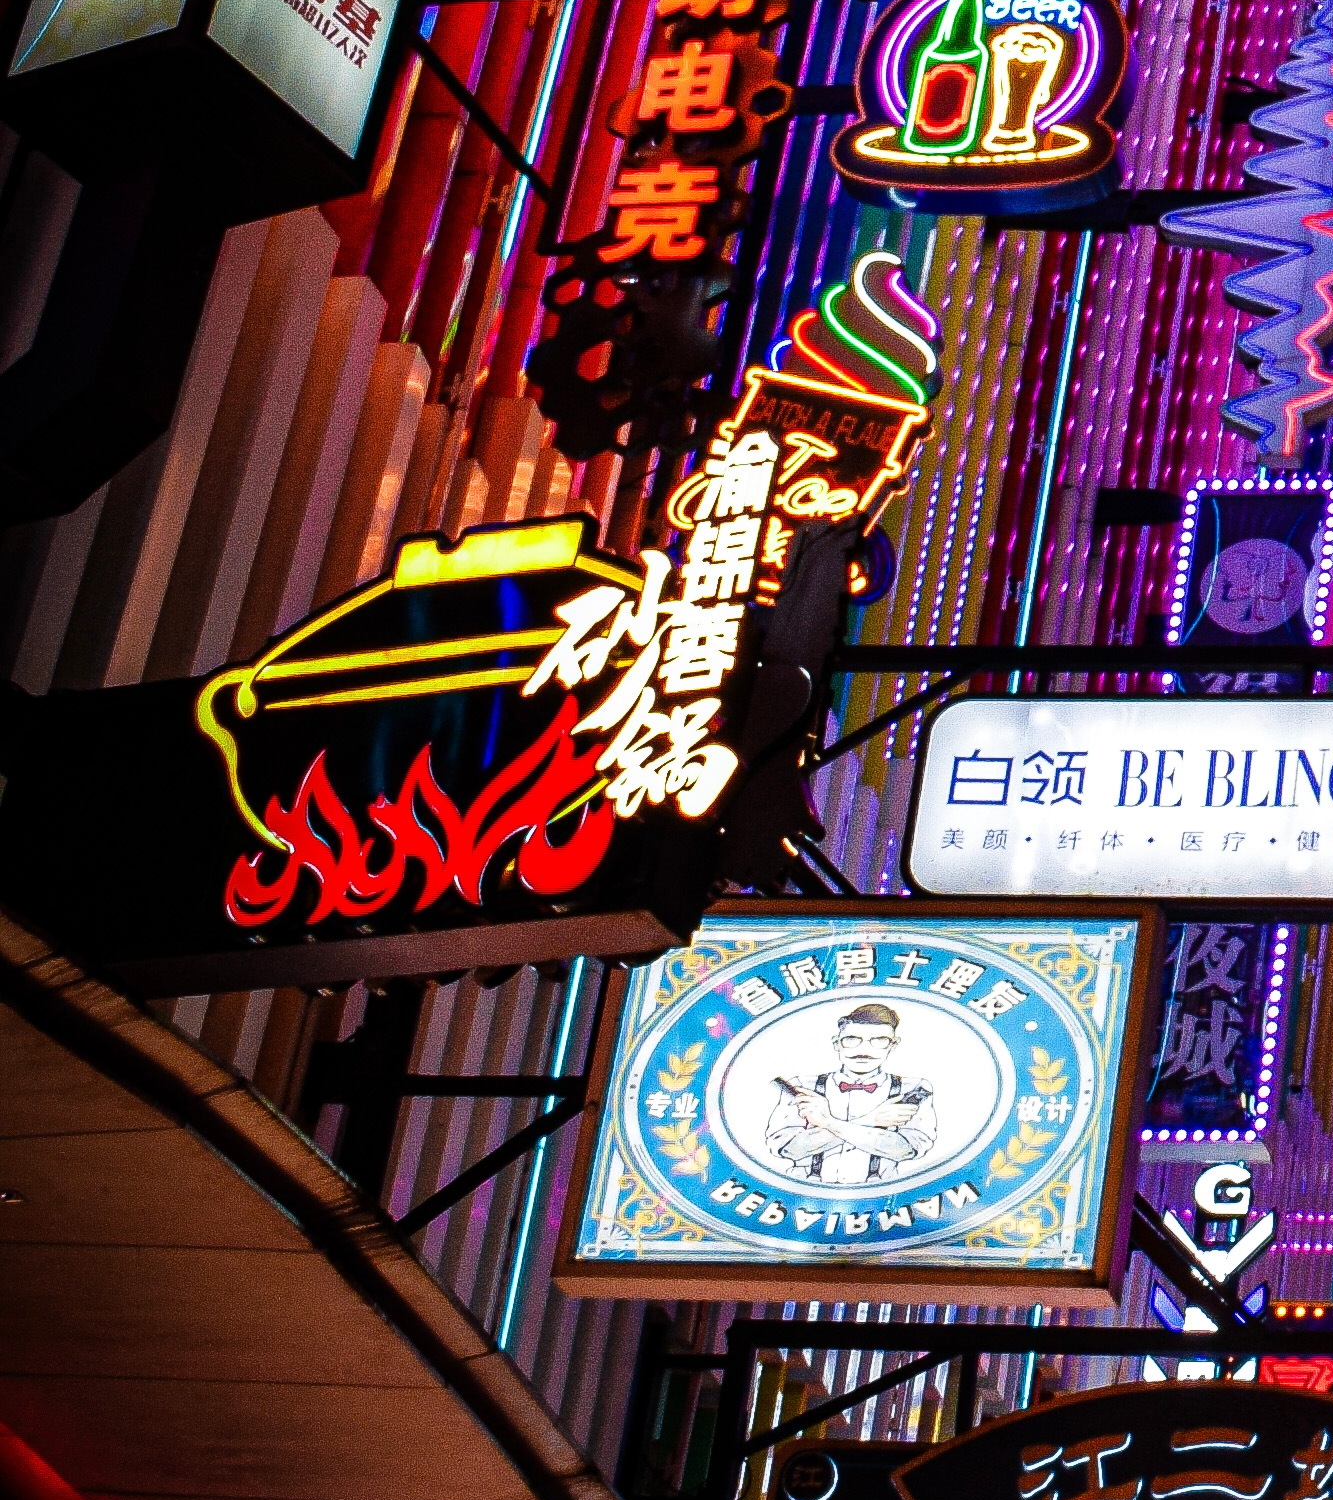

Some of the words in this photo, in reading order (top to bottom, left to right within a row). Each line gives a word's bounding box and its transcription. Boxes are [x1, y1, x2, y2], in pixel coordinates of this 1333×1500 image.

[947, 748, 1088, 806] 白领
[1118, 748, 1194, 807] BE
[645, 1091, 699, 1120] 专业
[1016, 1096, 1073, 1125] 设计
